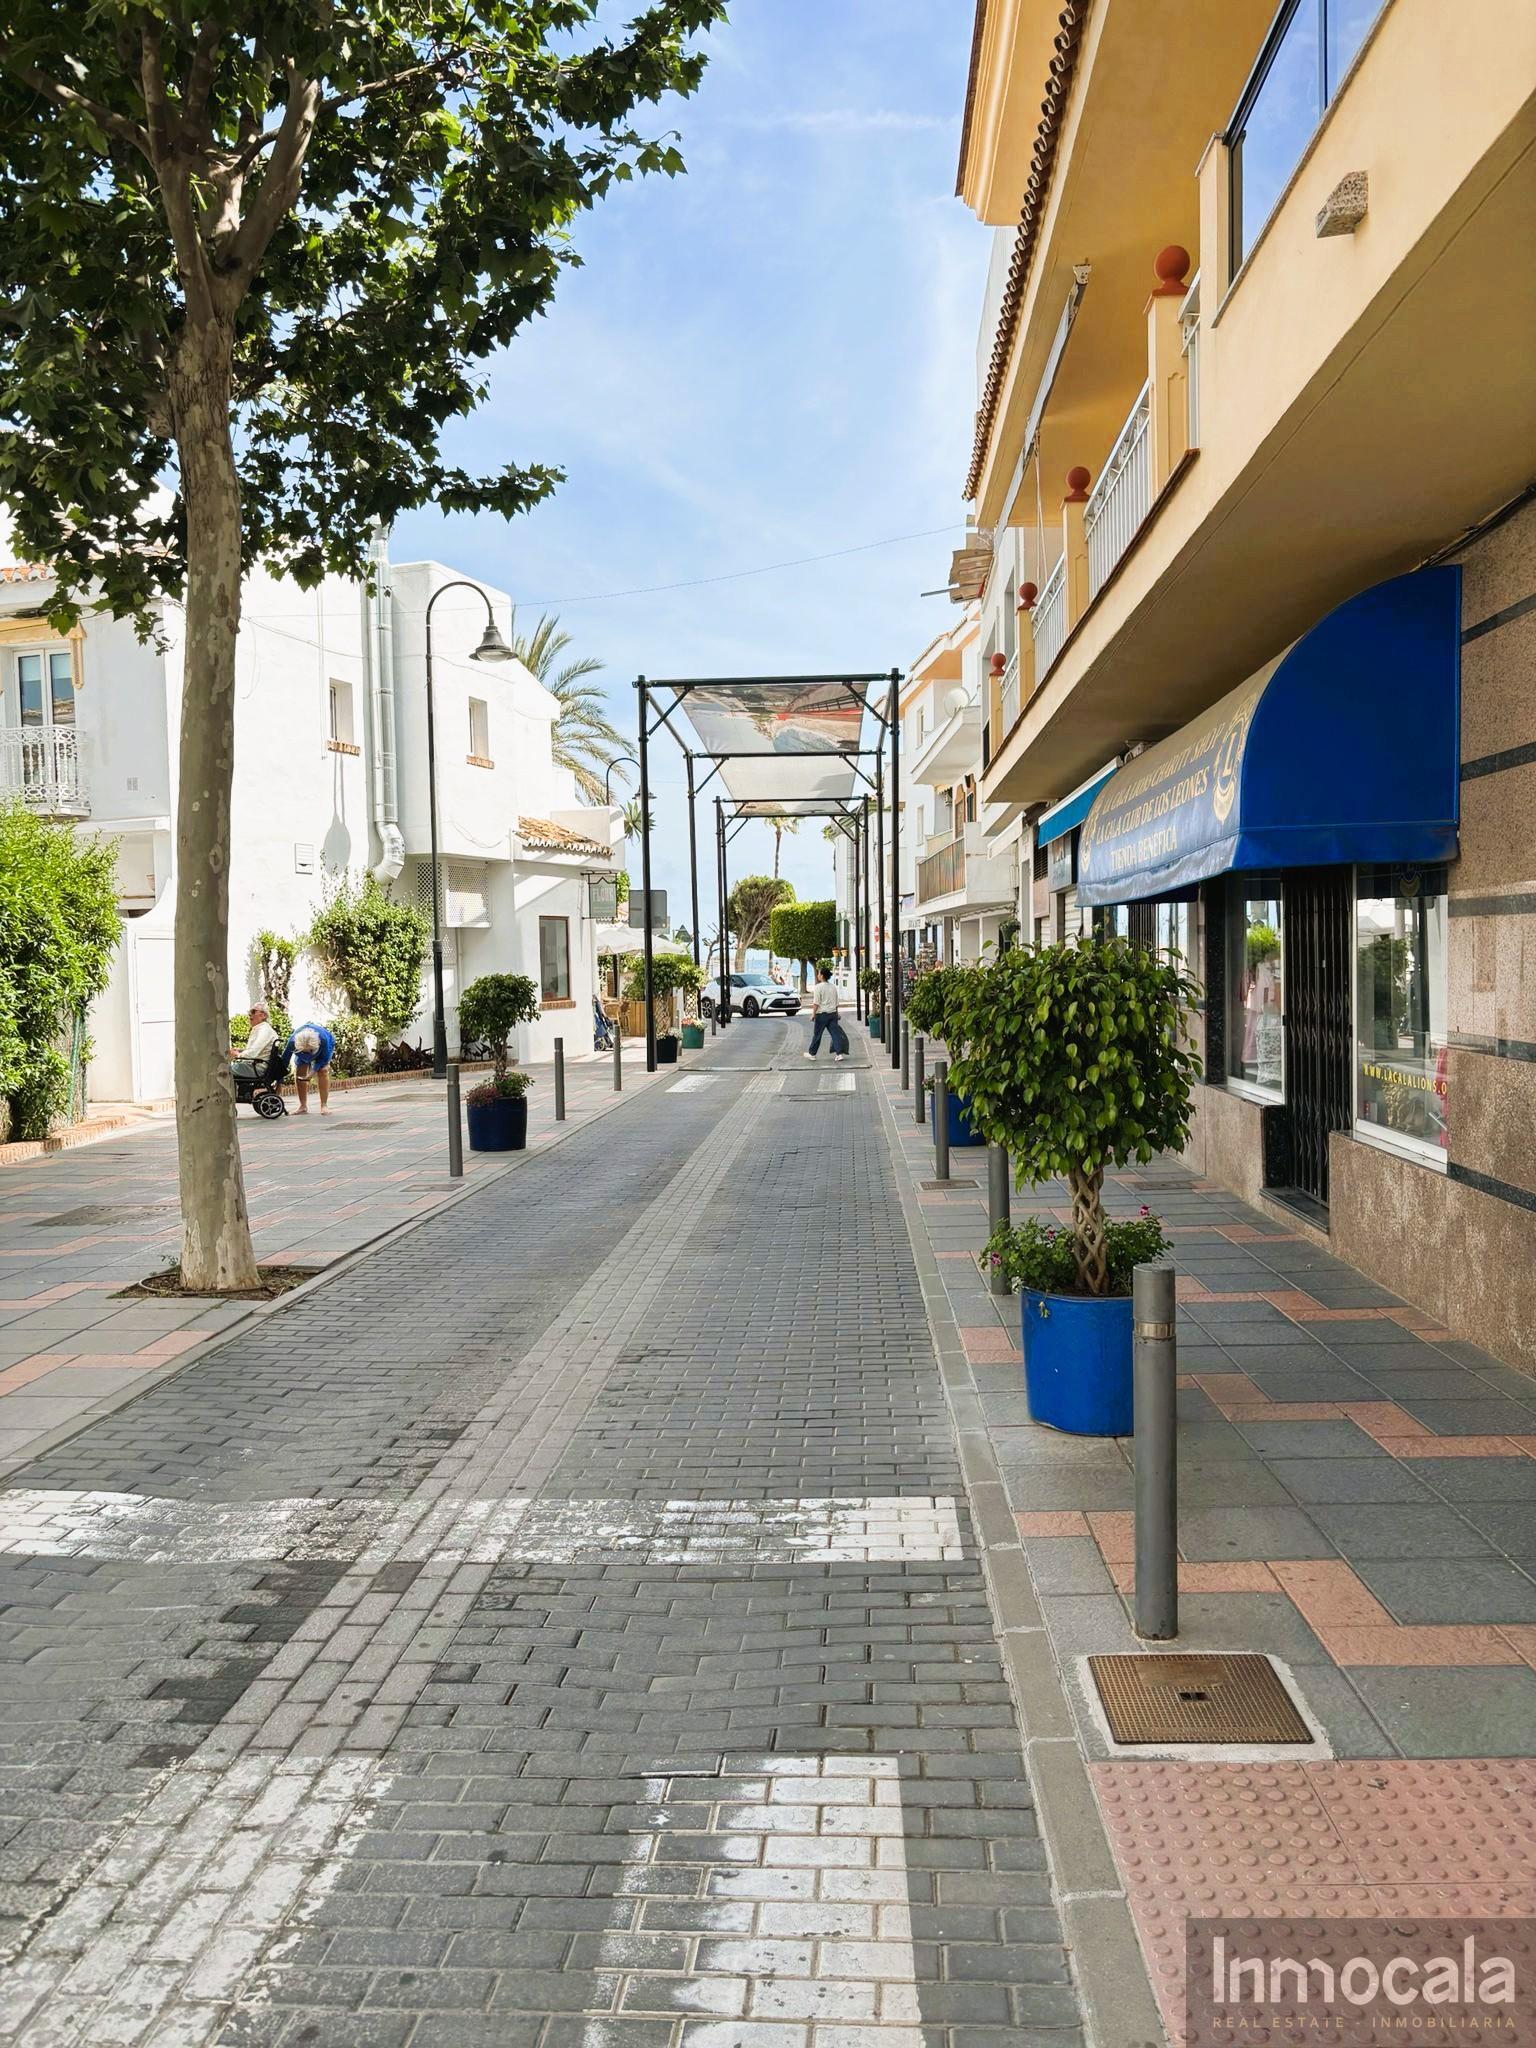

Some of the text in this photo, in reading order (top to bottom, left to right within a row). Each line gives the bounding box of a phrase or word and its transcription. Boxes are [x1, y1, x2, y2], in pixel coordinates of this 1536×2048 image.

[1151, 746, 1192, 787] CHARITY
[1104, 816, 1122, 841] CALA
[1122, 806, 1142, 834] CLUB
[1141, 799, 1154, 825] DE
[1153, 789, 1171, 819] LOS
[1170, 766, 1210, 810] LEONES
[1110, 824, 1178, 871] TIENDA BENEFICA
